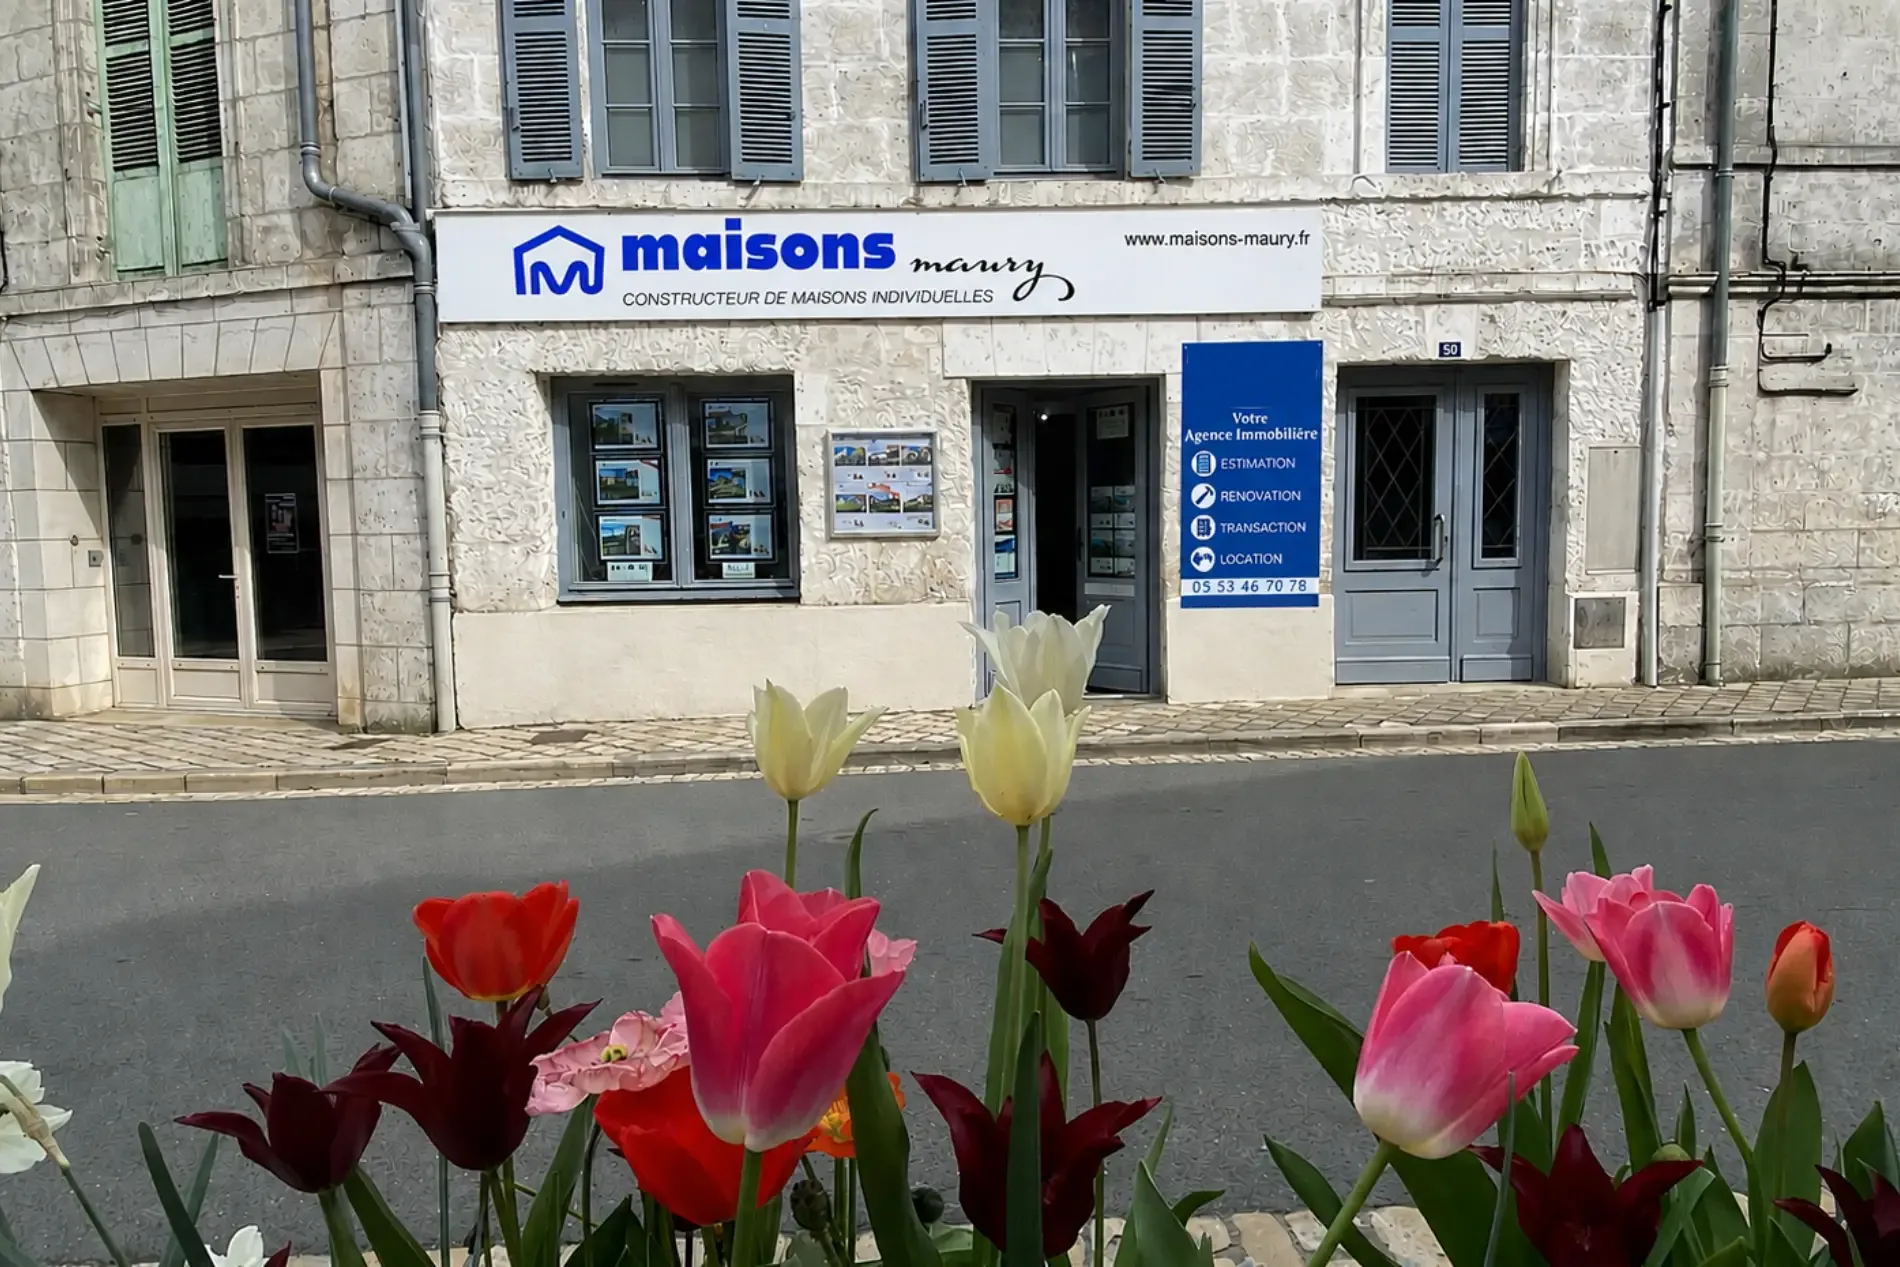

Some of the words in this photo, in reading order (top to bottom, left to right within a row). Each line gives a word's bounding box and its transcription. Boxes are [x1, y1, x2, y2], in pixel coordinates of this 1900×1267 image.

[1124, 228, 1311, 248] www.maisons-maury.fr
[622, 217, 896, 271] maisons
[909, 255, 1075, 302] maury
[622, 290, 760, 308] CONSTRUCTEUR
[764, 290, 788, 306] DE
[791, 289, 867, 305] MAISONS
[871, 287, 994, 304] INDIVIDUELLES
[1443, 343, 1458, 356] 50
[1232, 412, 1268, 424] Votre
[1184, 429, 1233, 445] Agence
[1220, 457, 1296, 470] ESTIMATION
[1220, 489, 1301, 502] RENOVATION
[1220, 521, 1307, 534] TRANSACTION
[1220, 553, 1283, 565] LOCATION
[1192, 580, 1211, 594] 05
[1217, 580, 1235, 593] 53
[1241, 579, 1259, 592] 46
[1265, 579, 1284, 592] 70
[1289, 579, 1307, 592] 78
